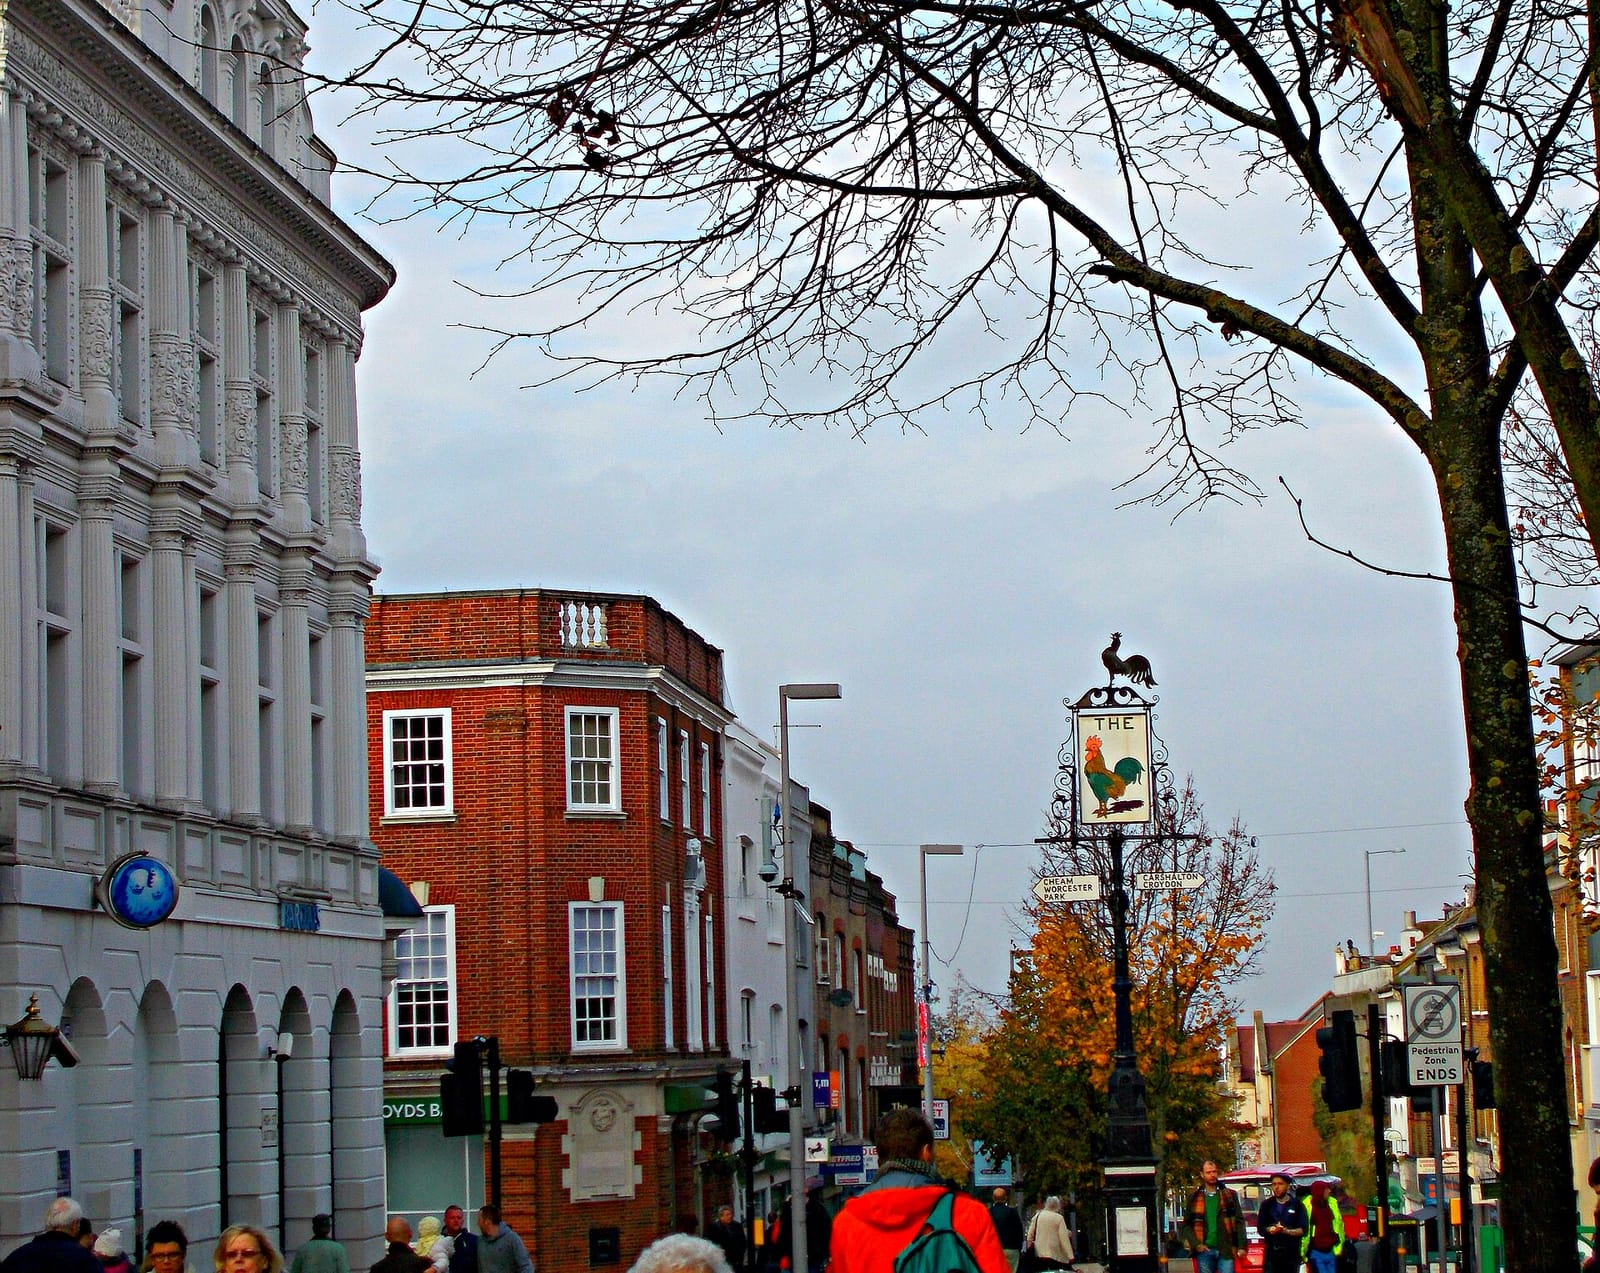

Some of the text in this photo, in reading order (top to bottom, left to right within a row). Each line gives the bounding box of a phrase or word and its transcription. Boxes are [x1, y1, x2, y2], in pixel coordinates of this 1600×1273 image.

[1094, 717, 1134, 730] THE
[1143, 873, 1198, 881] CARSHALTON
[1044, 884, 1093, 893] WORCESTER
[1411, 1046, 1459, 1055] Pedestrian
[1424, 1056, 1447, 1064] Zone
[1416, 1068, 1457, 1080] ENDS
[382, 1103, 426, 1118] OYDS
[831, 1155, 862, 1163] ETFRED
